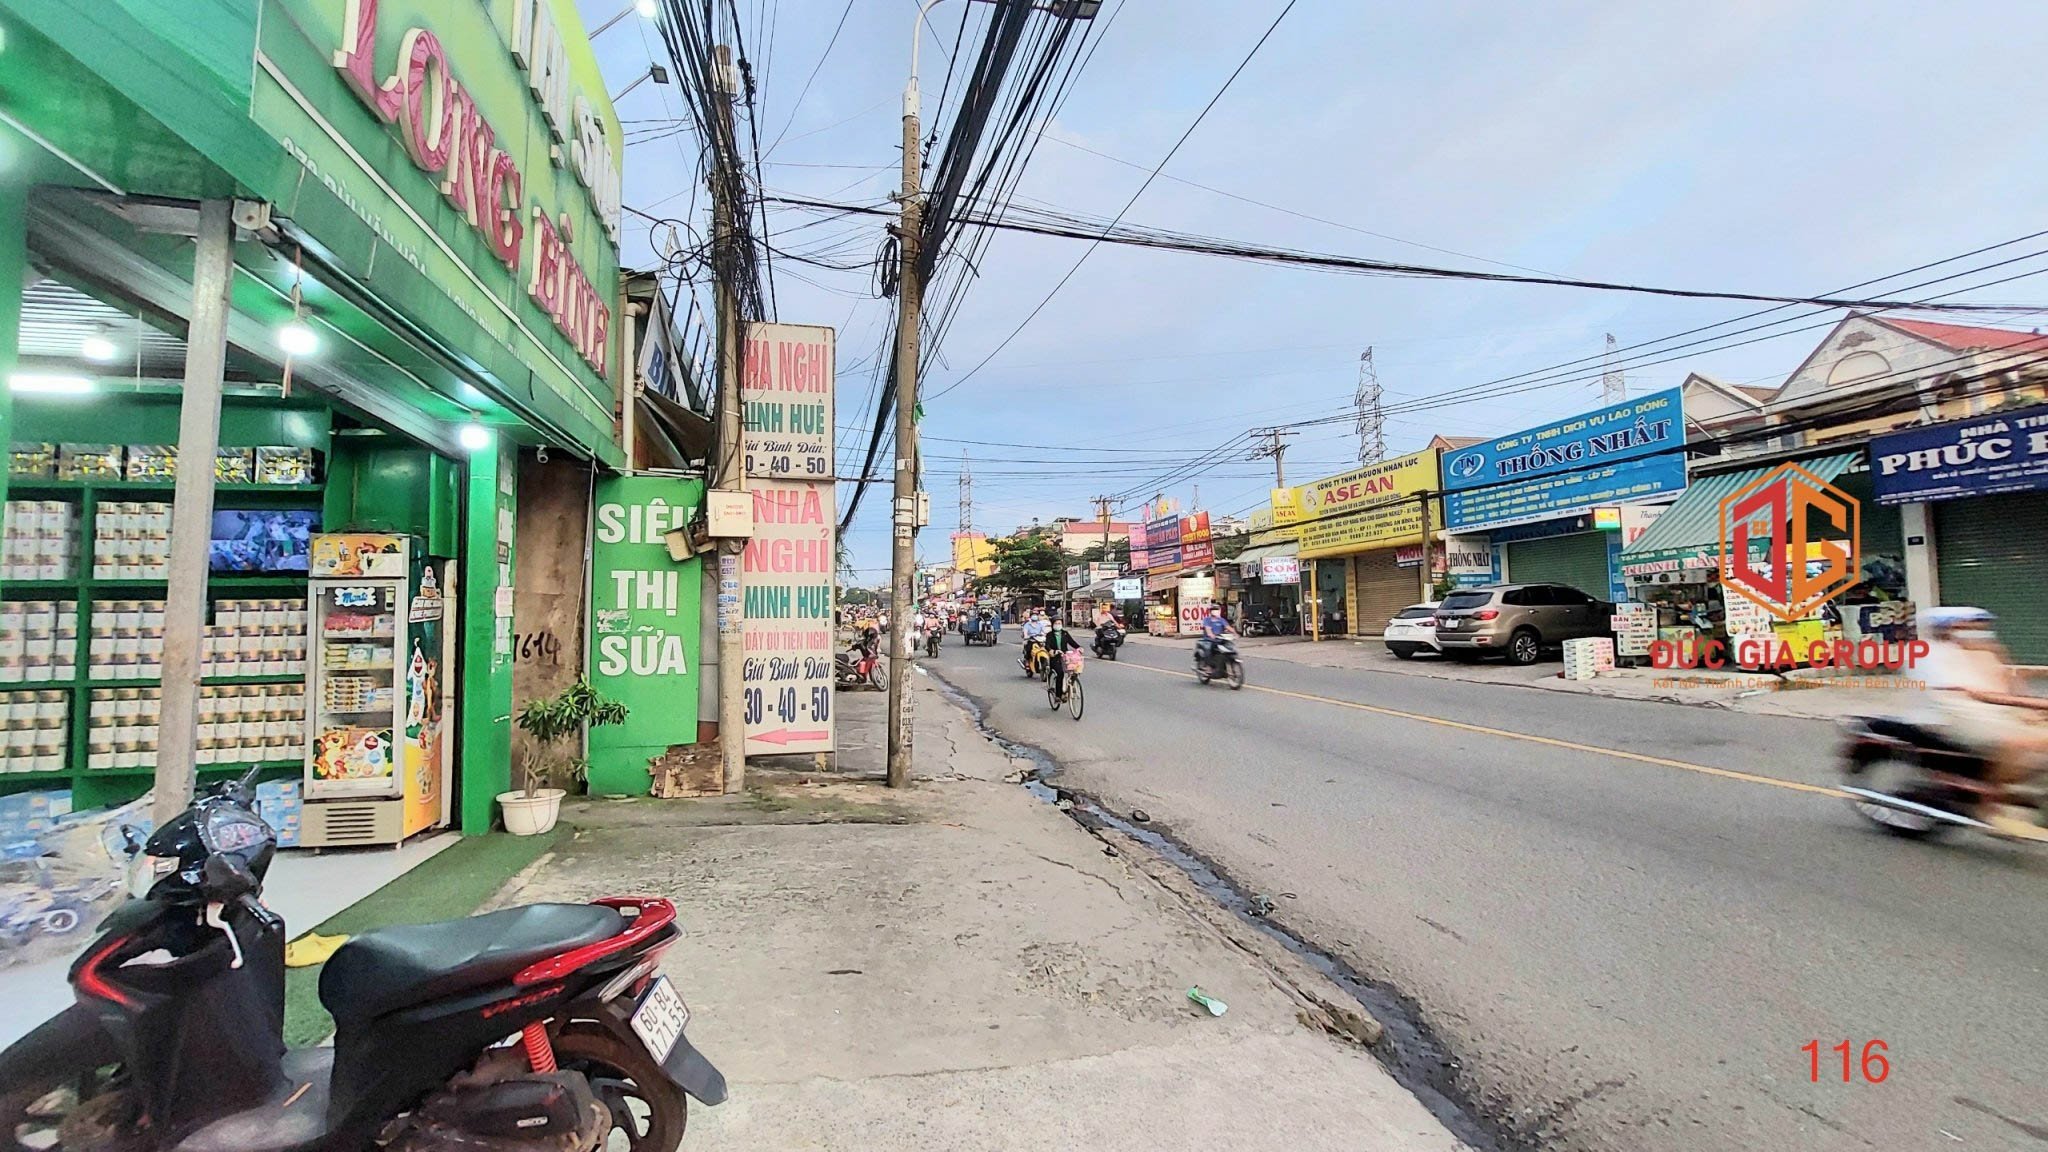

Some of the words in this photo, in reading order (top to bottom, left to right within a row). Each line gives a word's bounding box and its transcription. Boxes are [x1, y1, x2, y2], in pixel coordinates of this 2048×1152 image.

[333, 0, 523, 275] LONG
[743, 329, 772, 390] HÀ
[779, 330, 827, 393] NGHỈ
[790, 398, 825, 443] HUỆ
[1608, 408, 1631, 422] LAO
[1960, 420, 2010, 438] NHÀ
[764, 440, 793, 453] Bình
[771, 456, 790, 473] 40
[806, 457, 826, 474] 50
[1496, 442, 1584, 477] THỐNG
[1589, 416, 1671, 457] NHẤT
[1878, 439, 2013, 476] PHÚC
[752, 483, 825, 525] NHÀ
[1324, 475, 1394, 506] ASEAN
[743, 528, 829, 573] NGHỈ
[611, 571, 678, 616] THỊ
[744, 585, 791, 619] MINH
[797, 578, 830, 628] HUỆ
[599, 625, 687, 676] SỮA
[742, 658, 767, 682] Giá
[769, 656, 799, 683] Bình
[803, 657, 830, 681] Dân
[744, 686, 763, 725] 30
[778, 686, 796, 724] 40
[811, 686, 829, 722] 50
